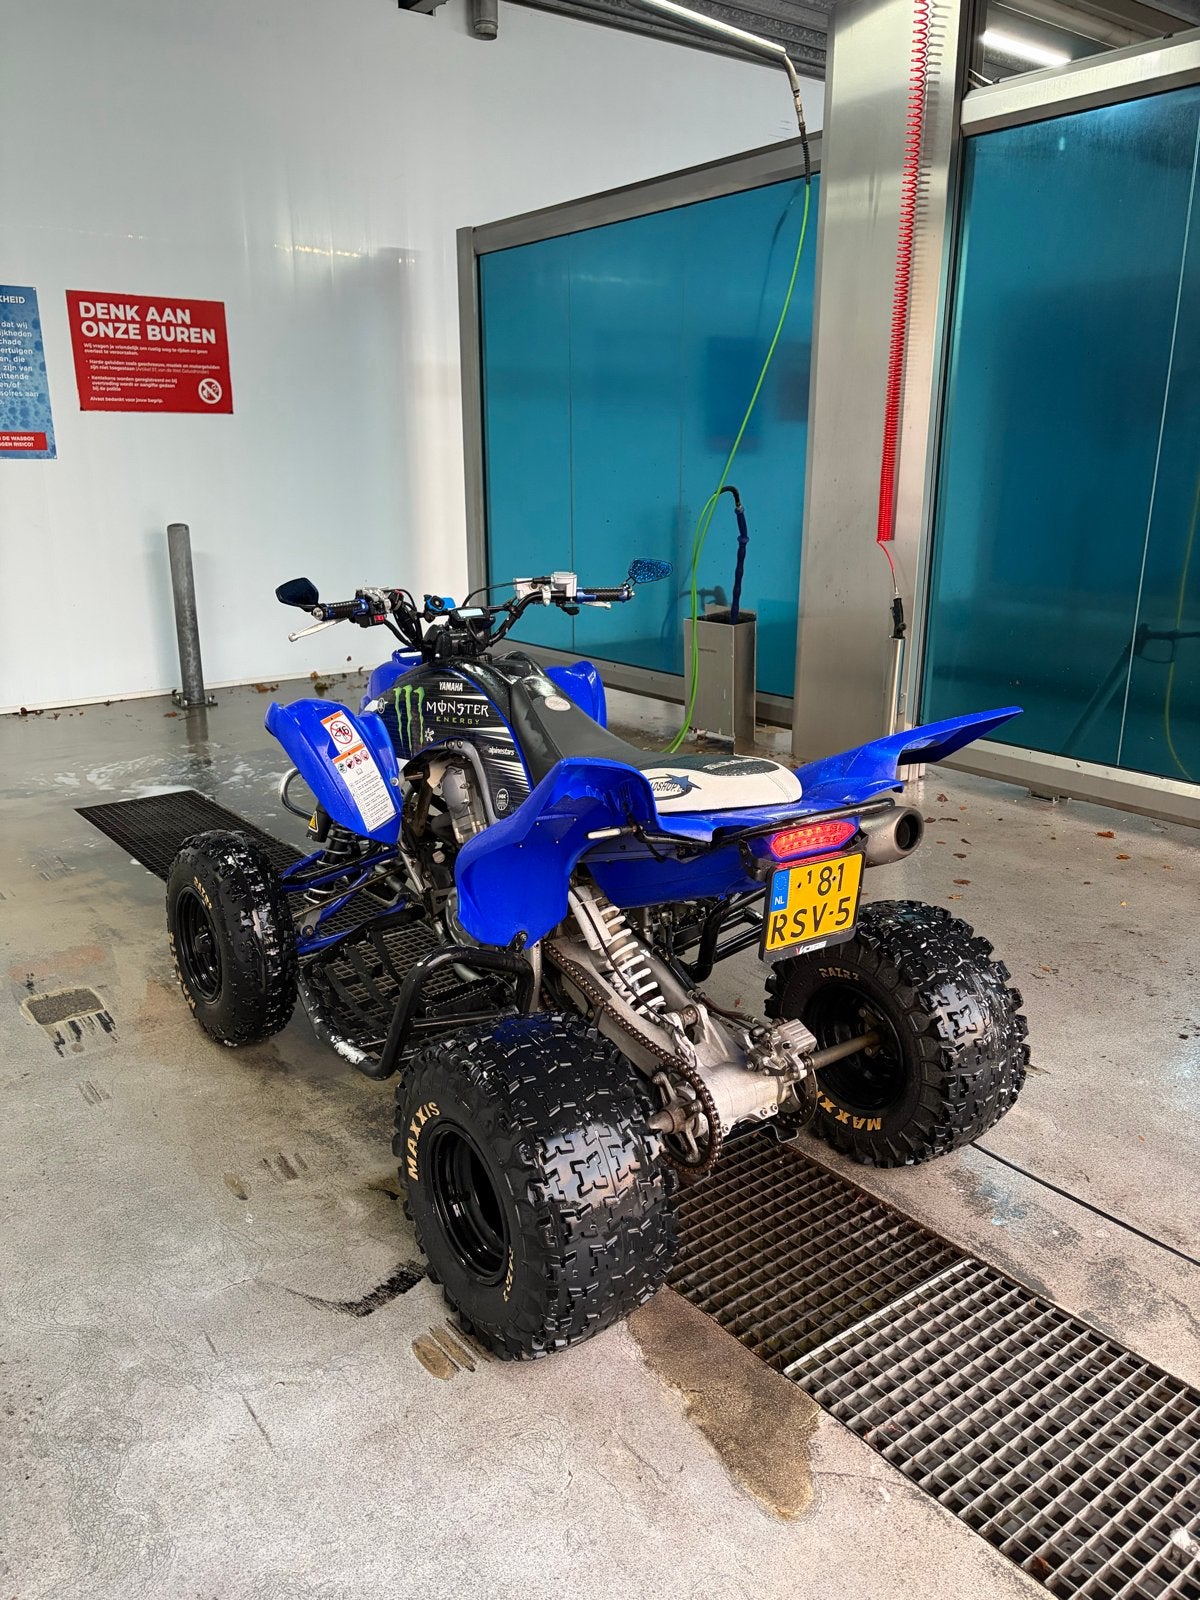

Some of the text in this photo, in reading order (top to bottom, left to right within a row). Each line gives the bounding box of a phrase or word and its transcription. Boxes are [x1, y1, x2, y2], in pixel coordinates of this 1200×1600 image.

[79, 301, 191, 325] DENK AAN
[16, 321, 28, 329] wij
[81, 320, 216, 344] ONZE BUREN
[439, 681, 464, 692] YAMAHA
[426, 700, 489, 717] MONSTER
[436, 716, 480, 725] ENERGY
[488, 746, 515, 756] alpinestars
[774, 895, 785, 906] NL
[770, 896, 851, 945] RSV-5
[407, 1101, 441, 1181] MAXXIS
